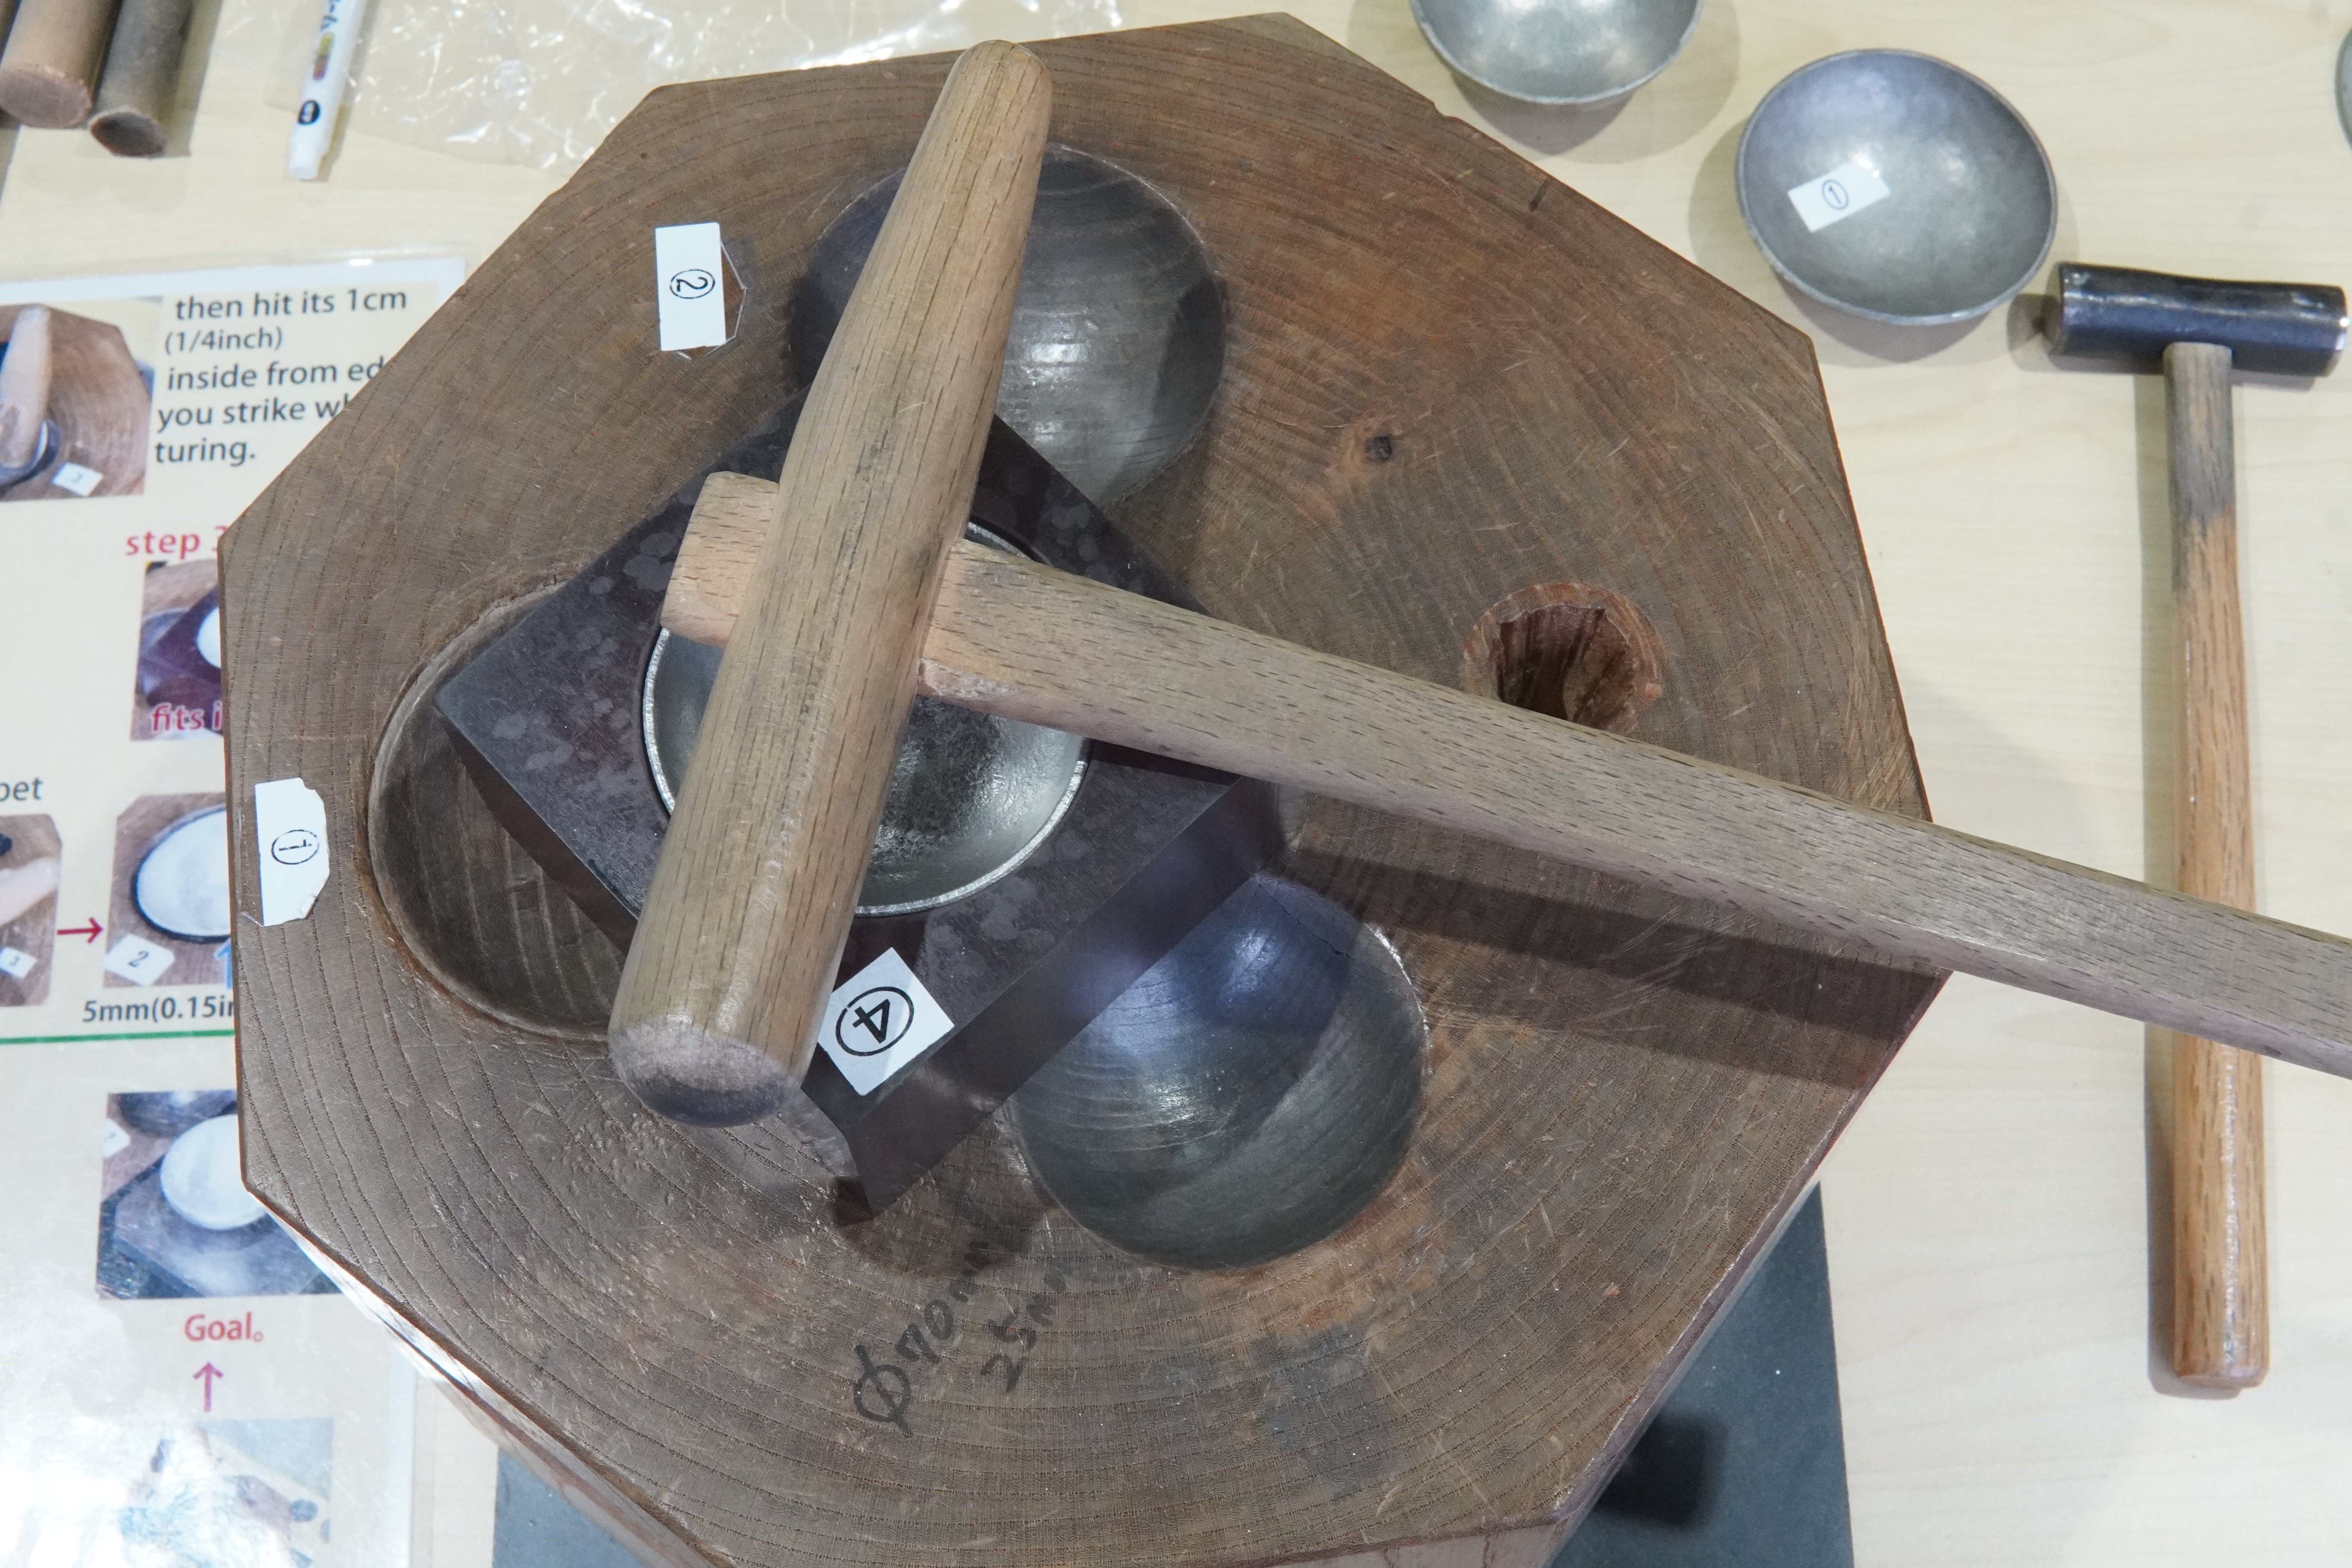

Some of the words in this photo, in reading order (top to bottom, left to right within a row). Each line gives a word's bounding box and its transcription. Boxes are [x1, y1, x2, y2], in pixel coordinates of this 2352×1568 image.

[176, 296, 242, 320] then
[252, 292, 292, 316] hit
[302, 291, 334, 313] its
[348, 289, 406, 310] 1cm
[165, 326, 283, 356] (1/4inch)
[168, 363, 257, 390] inside
[267, 361, 337, 386] from
[157, 406, 213, 434] you
[223, 397, 305, 424] strike
[154, 437, 256, 467] turing.
[125, 531, 200, 560] step
[152, 704, 203, 731] fits
[128, 950, 150, 968] 2
